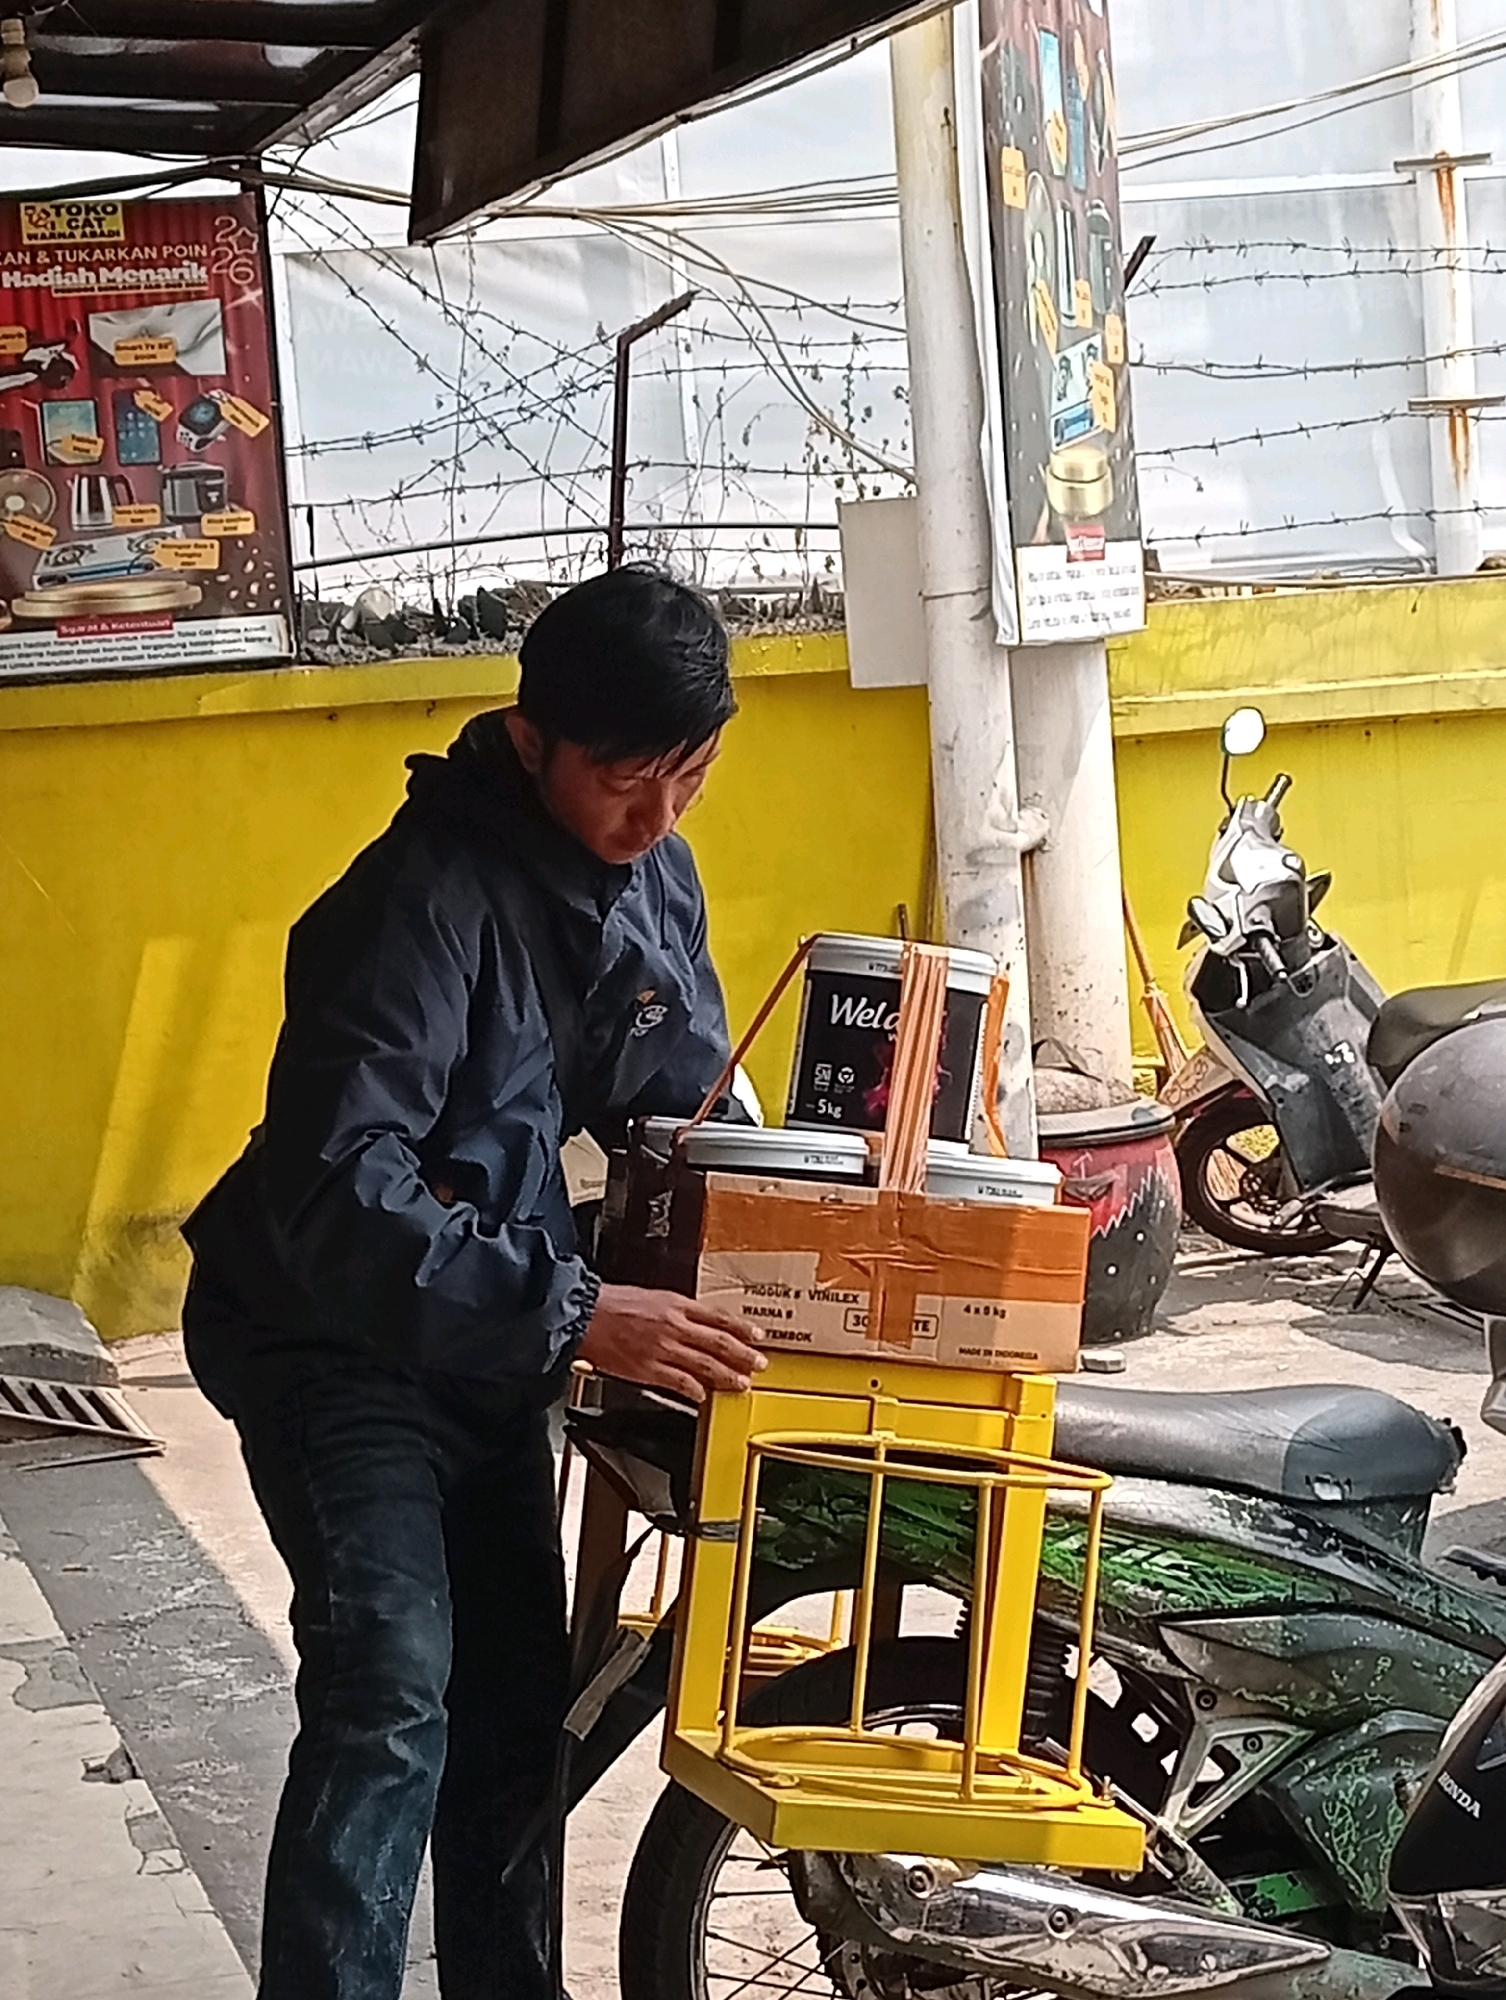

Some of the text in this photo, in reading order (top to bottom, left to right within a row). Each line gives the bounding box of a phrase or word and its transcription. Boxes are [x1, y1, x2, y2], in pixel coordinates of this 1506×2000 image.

[50, 203, 118, 217] TOKO
[66, 217, 106, 230] CAT
[27, 231, 76, 240] WARNA
[36, 250, 50, 263] &
[55, 247, 157, 262] TUKARKAN
[162, 244, 207, 258] POIN
[2, 260, 208, 288] Hadiah Menarik
[743, 1284, 792, 1298] PRODUK
[808, 1288, 860, 1304] VINILEX
[742, 1305, 782, 1318] WARNA
[963, 1304, 971, 1314] 4
[993, 1306, 1006, 1319] kg
[765, 1328, 813, 1342] TEMBOK
[958, 1347, 1038, 1360] MADE IN INDONESIA
[1438, 1771, 1480, 1819] HONDA
